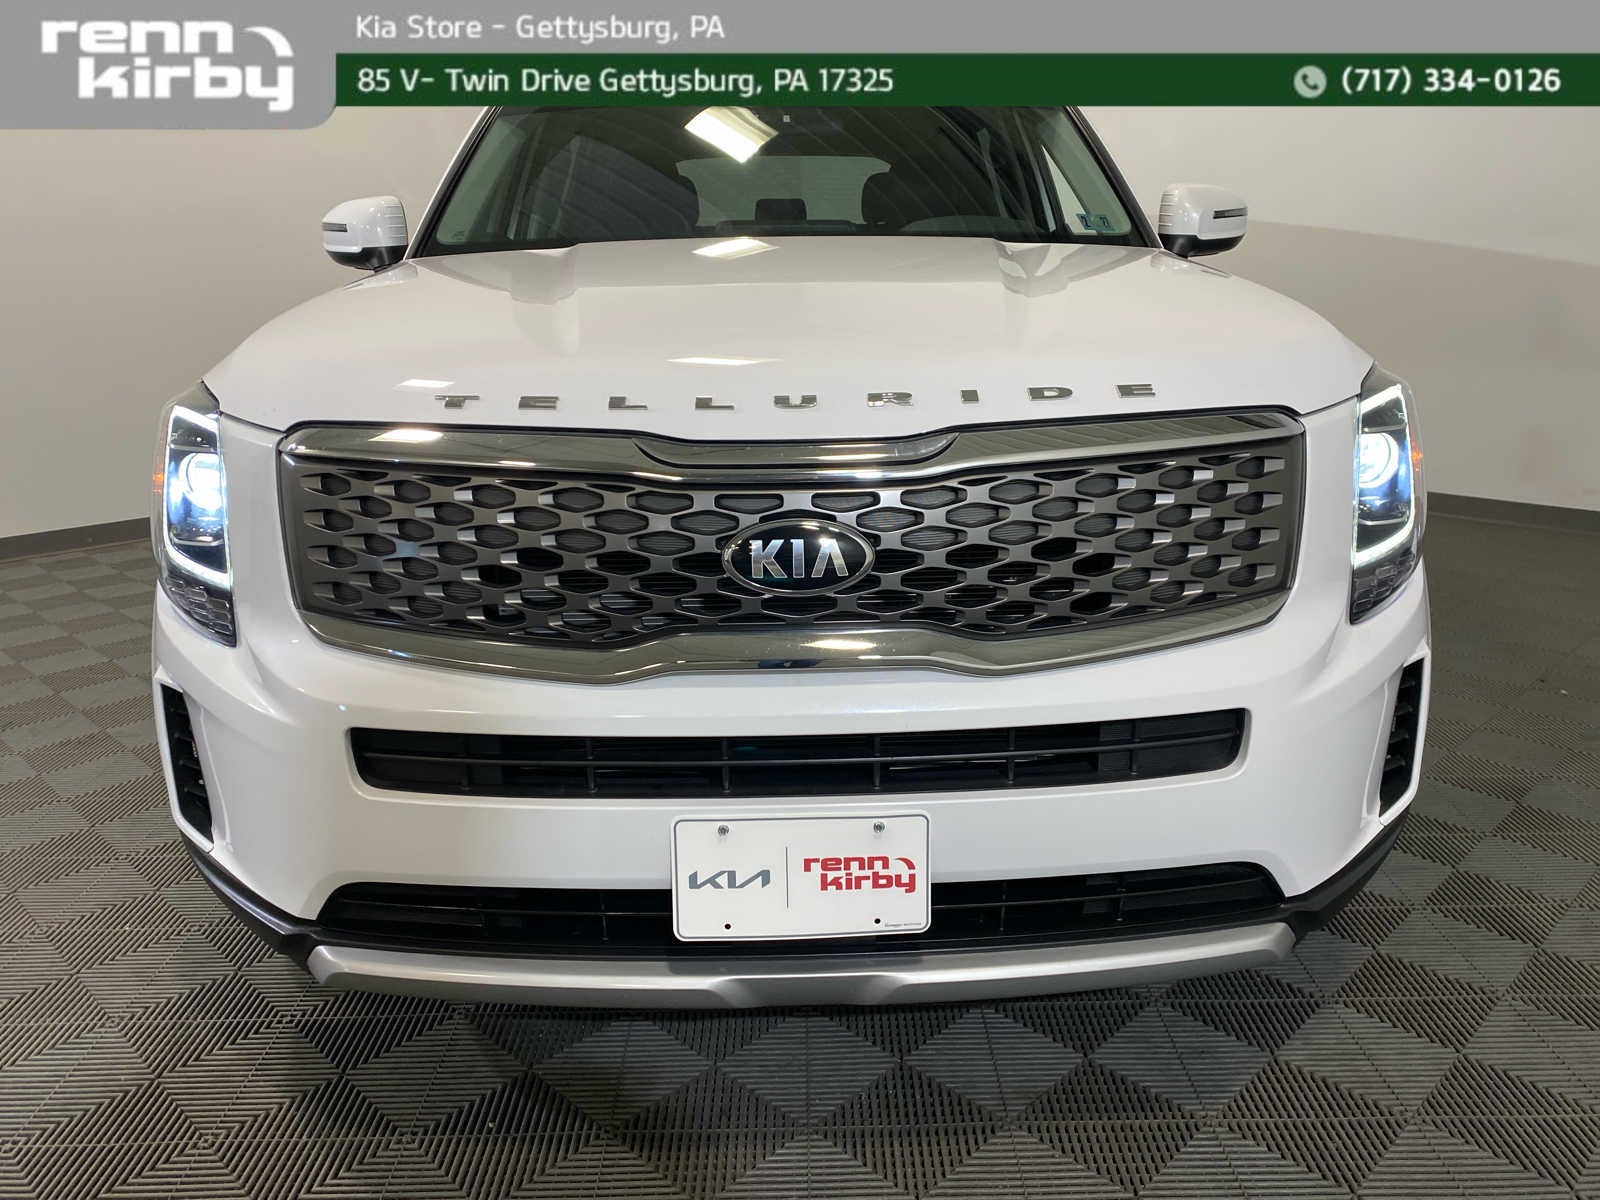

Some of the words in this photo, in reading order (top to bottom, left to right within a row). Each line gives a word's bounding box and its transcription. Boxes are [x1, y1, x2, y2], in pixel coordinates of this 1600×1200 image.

[750, 538, 849, 579] KIA
[803, 855, 890, 873] renn
[820, 871, 916, 894] kirby
